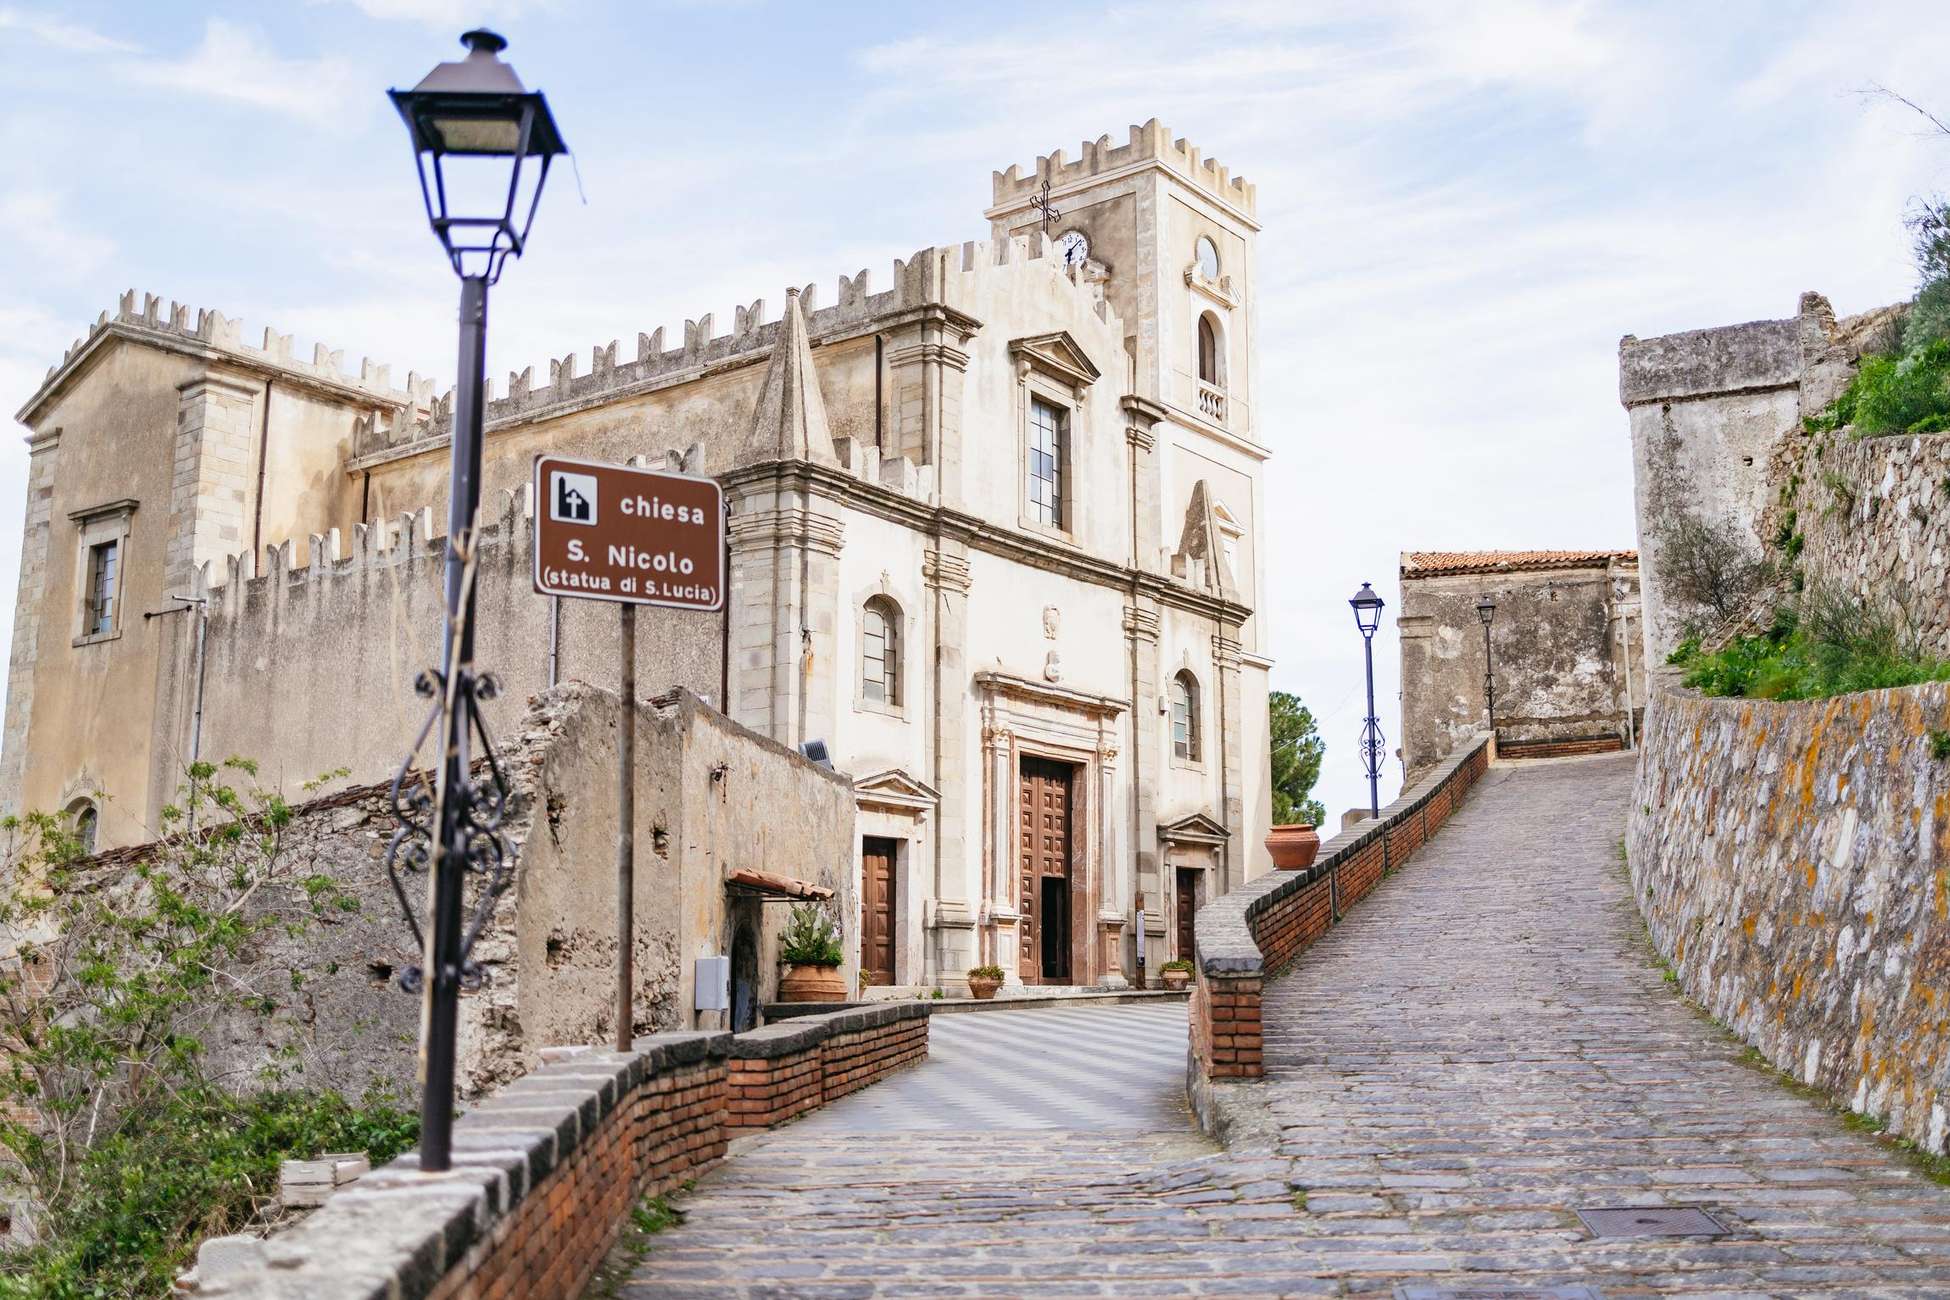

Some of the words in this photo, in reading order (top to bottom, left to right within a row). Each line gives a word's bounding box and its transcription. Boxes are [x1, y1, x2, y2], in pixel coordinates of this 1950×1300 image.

[620, 495, 705, 525] chiesa
[567, 539, 590, 563] S.
[608, 544, 694, 575] Nicolo
[543, 565, 611, 589] (statua
[620, 577, 637, 593] di
